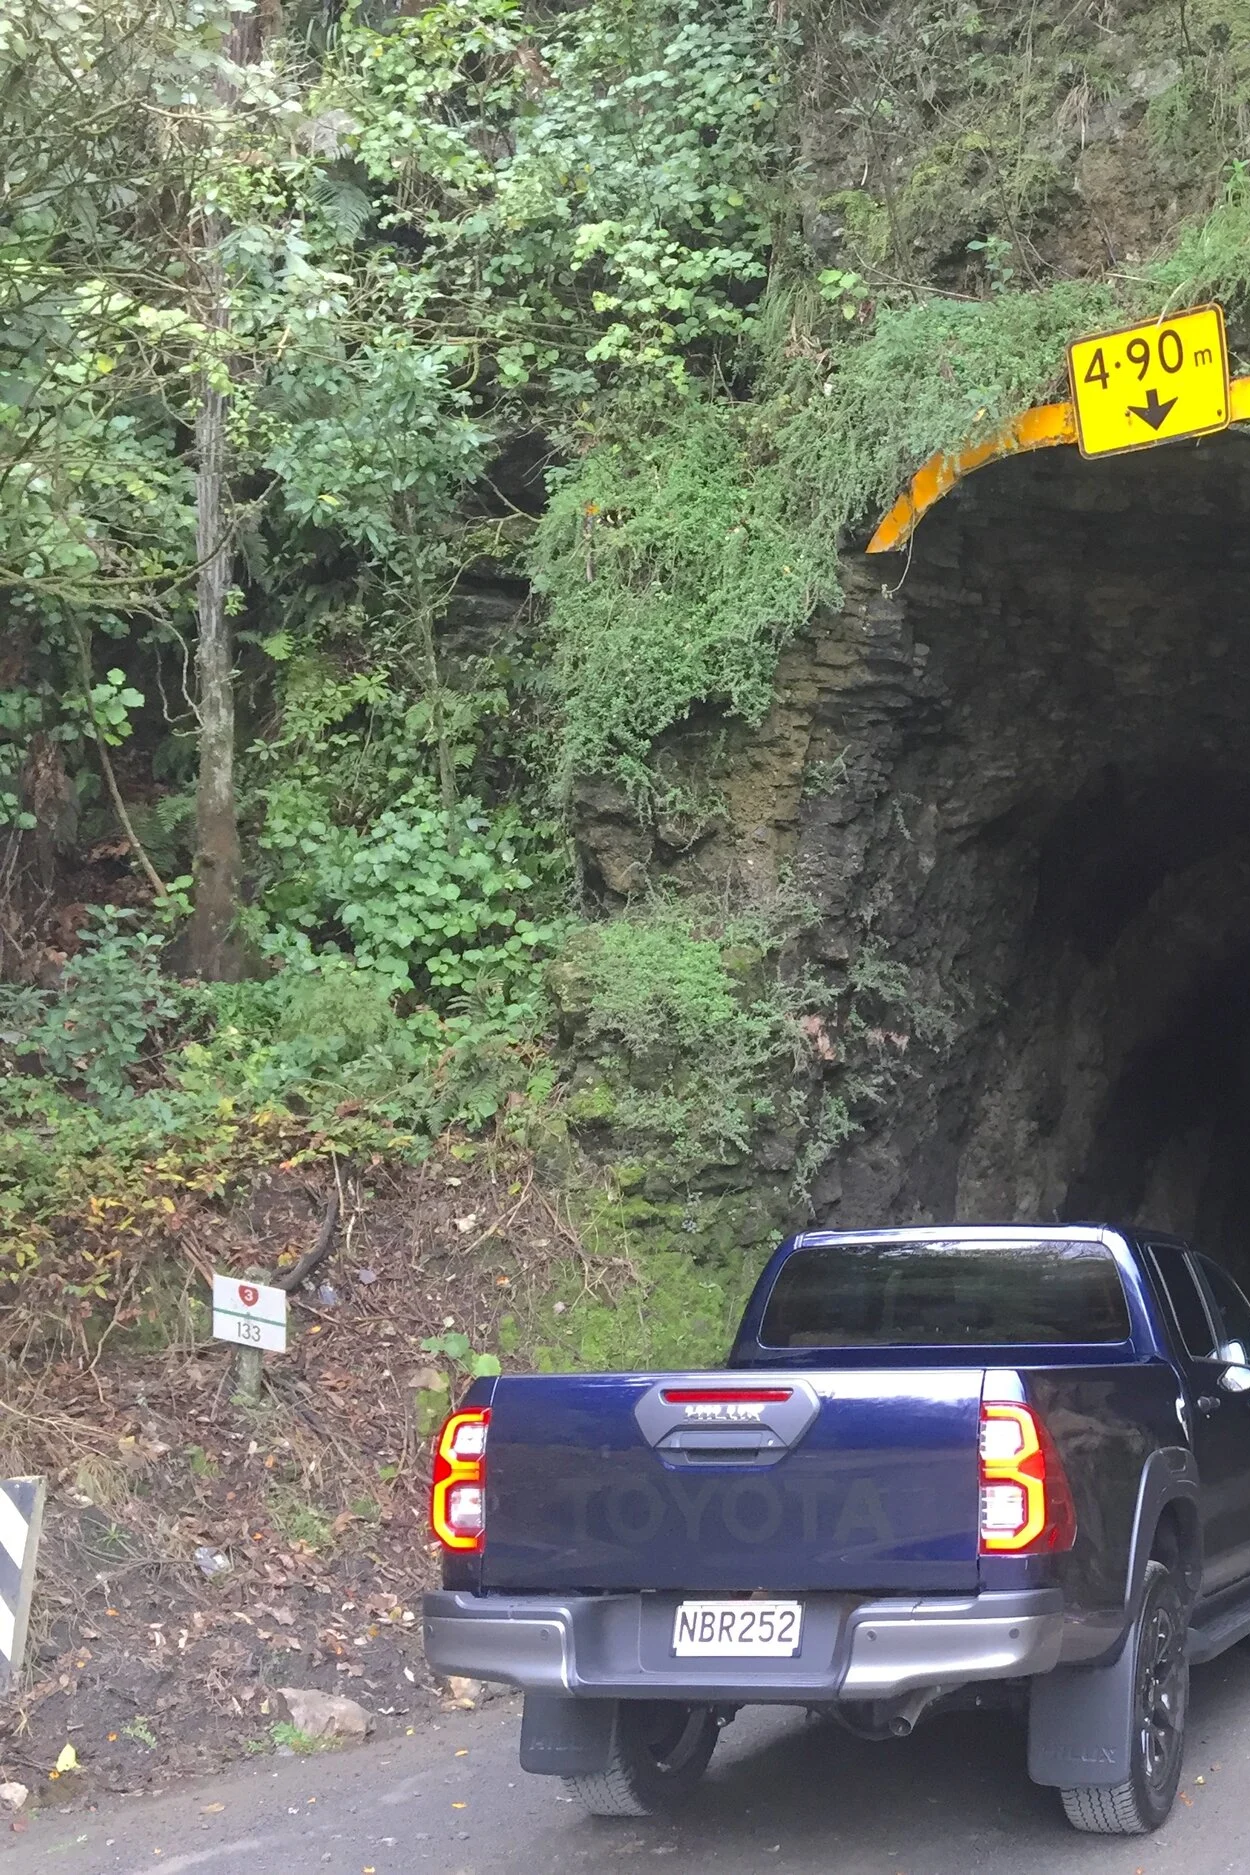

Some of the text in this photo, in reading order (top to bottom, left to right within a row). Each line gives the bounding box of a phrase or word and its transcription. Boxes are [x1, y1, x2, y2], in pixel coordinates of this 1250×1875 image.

[1193, 348, 1213, 367] m
[244, 1289, 253, 1302] 3
[237, 1321, 261, 1342] 133
[556, 1477, 896, 1544] TOYOTA
[678, 1611, 796, 1642] NBR252
